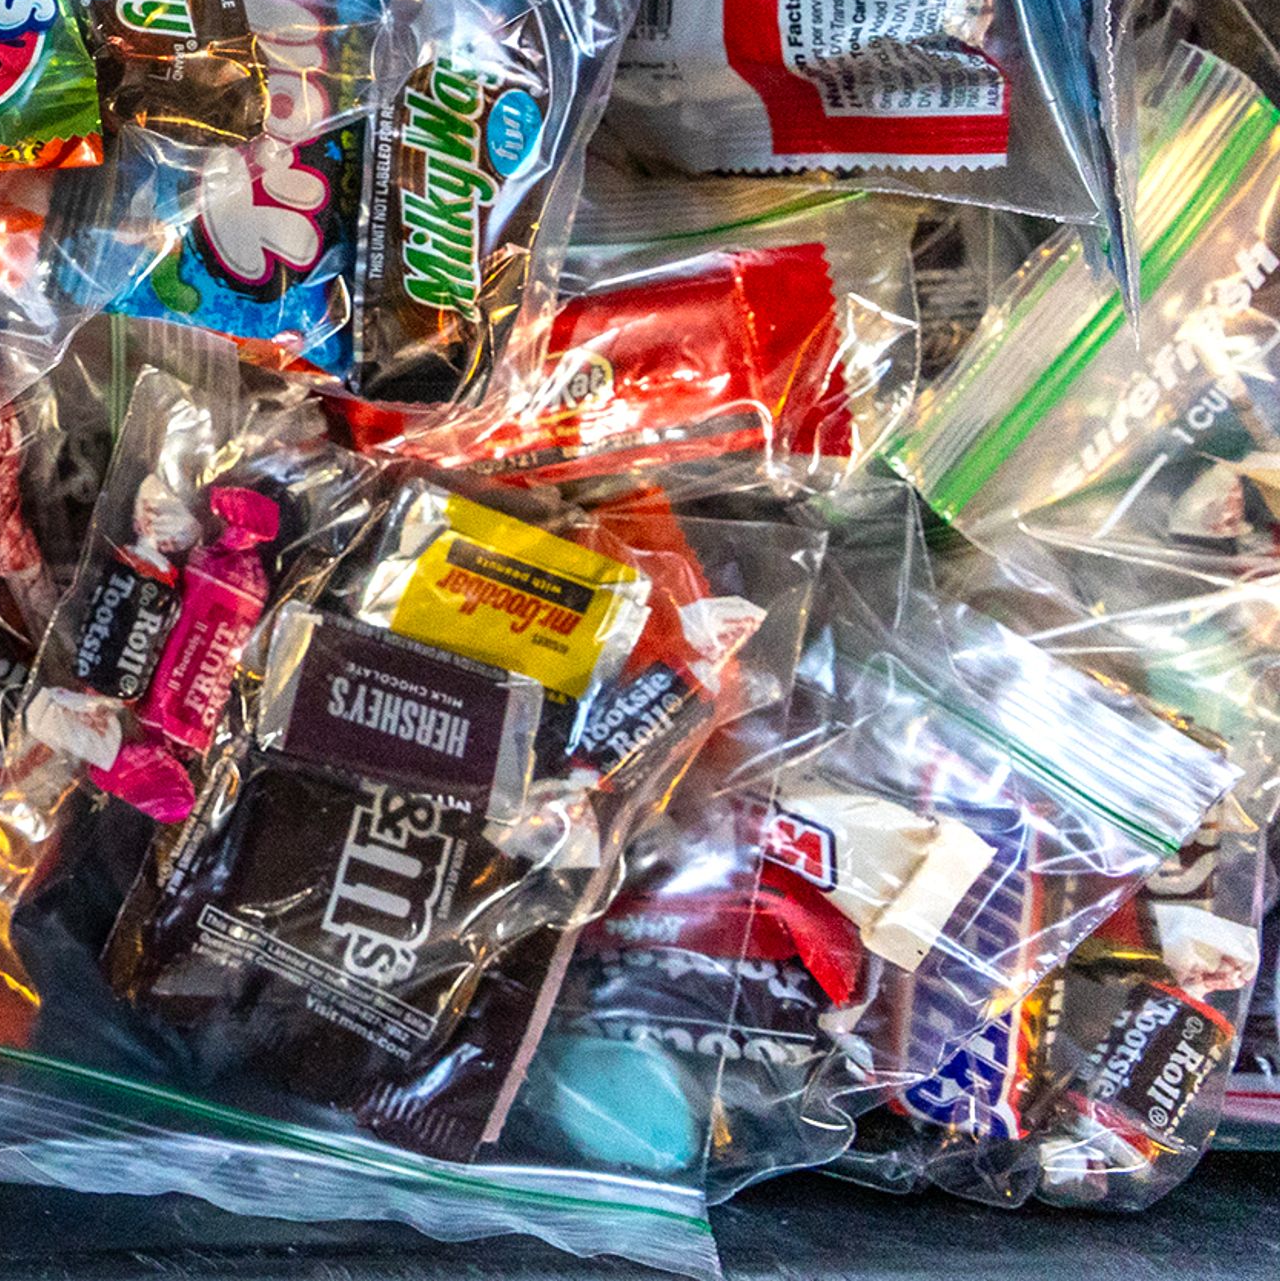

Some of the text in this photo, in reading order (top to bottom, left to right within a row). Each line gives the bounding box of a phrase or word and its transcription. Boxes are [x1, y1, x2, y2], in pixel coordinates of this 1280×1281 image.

[173, 43, 185, 82] BRAND
[494, 101, 524, 164] fun
[371, 118, 392, 280] THIS UNIT NOT LABELED FOR
[404, 160, 498, 322] Milky
[77, 571, 135, 680] Tootsie
[184, 623, 237, 711] FRUIT
[328, 675, 469, 758] HERSHEY'S
[346, 661, 465, 708] MILK CHOCOLATE
[578, 670, 669, 752] Tootsie
[340, 1010, 412, 1061] mms.com
[1101, 996, 1178, 1102] Tootsie
